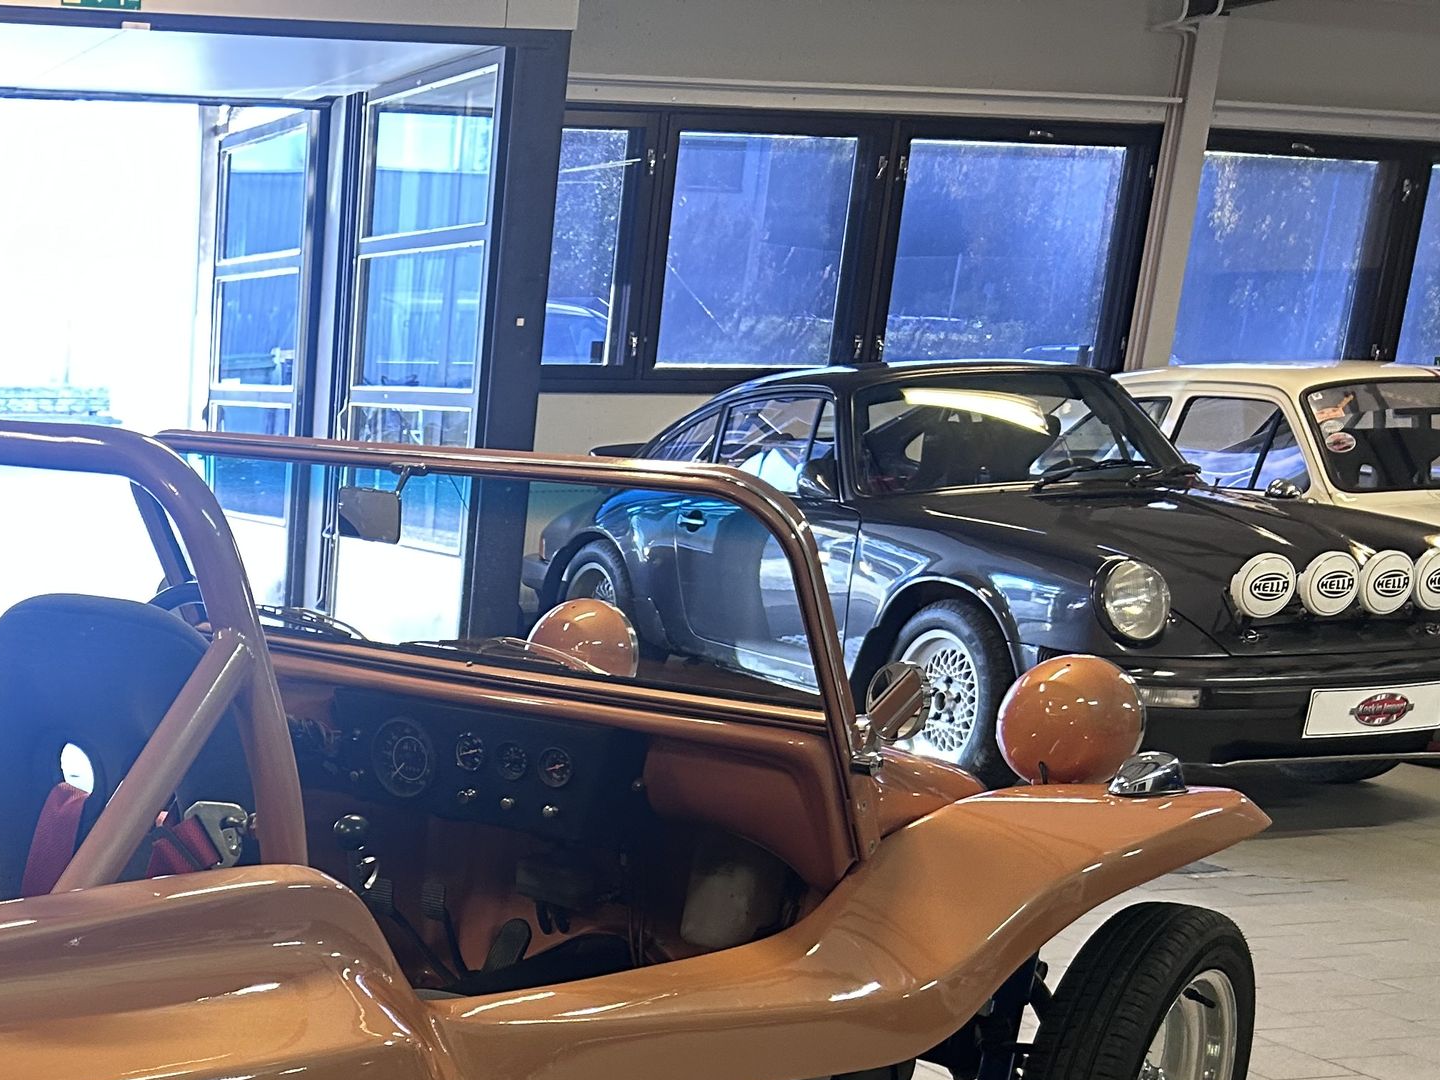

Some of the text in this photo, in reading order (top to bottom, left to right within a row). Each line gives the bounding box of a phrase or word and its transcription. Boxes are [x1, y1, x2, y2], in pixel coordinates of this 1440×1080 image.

[1253, 580, 1290, 593] HELLA
[1320, 577, 1355, 591] HELLA
[1376, 576, 1410, 589] HELLA
